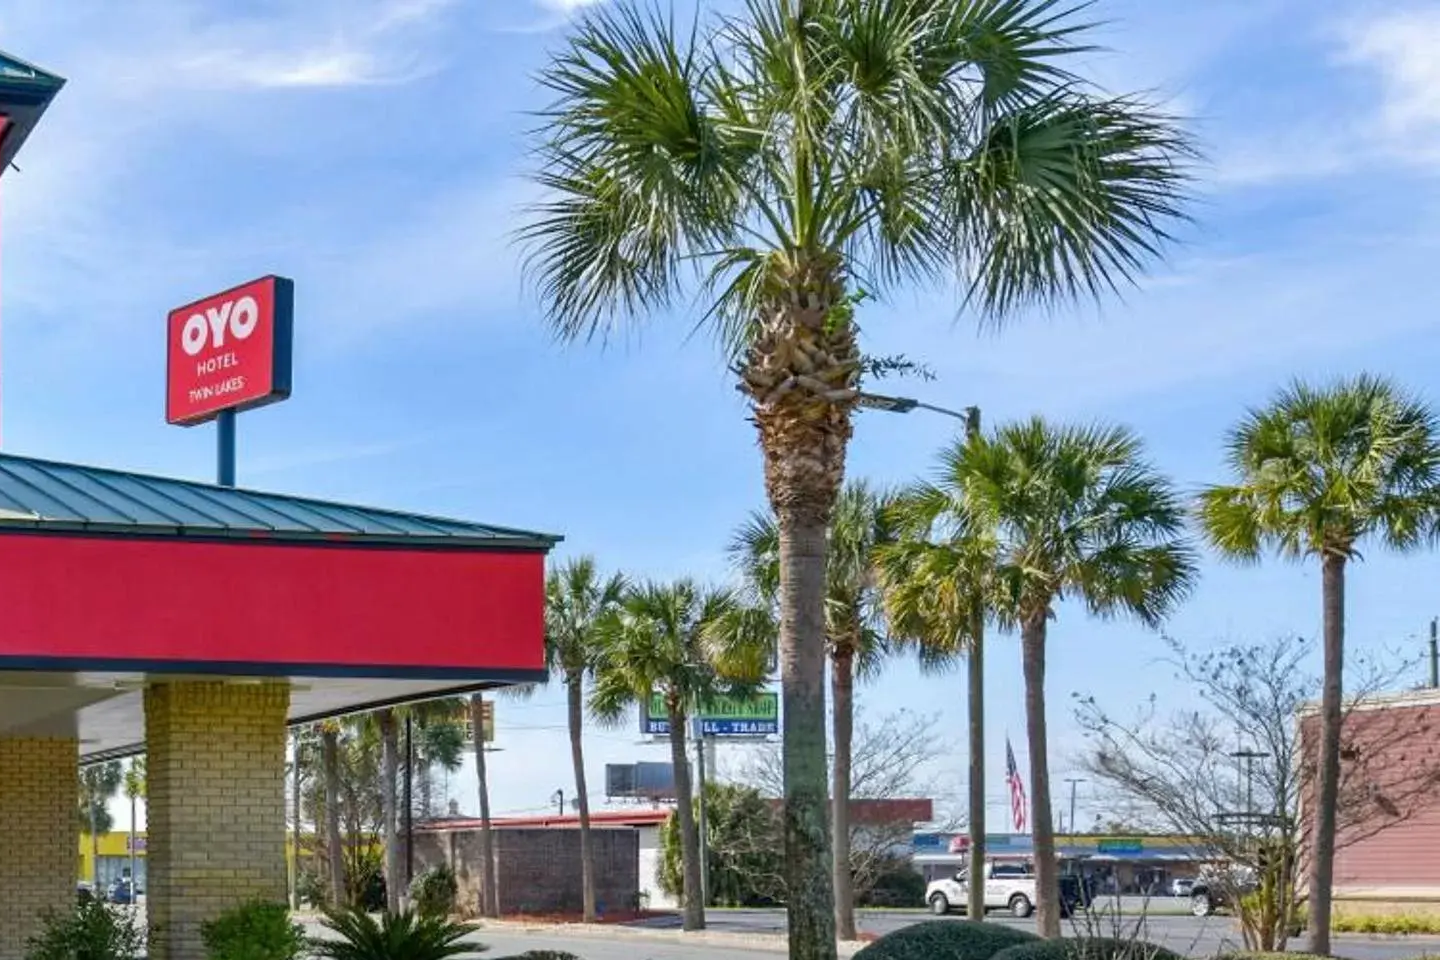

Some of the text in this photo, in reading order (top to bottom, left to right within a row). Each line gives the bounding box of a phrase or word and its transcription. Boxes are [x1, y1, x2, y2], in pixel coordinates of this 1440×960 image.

[182, 296, 258, 356] OYO
[197, 352, 238, 376] HOTEL
[188, 376, 244, 403] TWIN LAKES
[731, 721, 775, 733] TRADE
